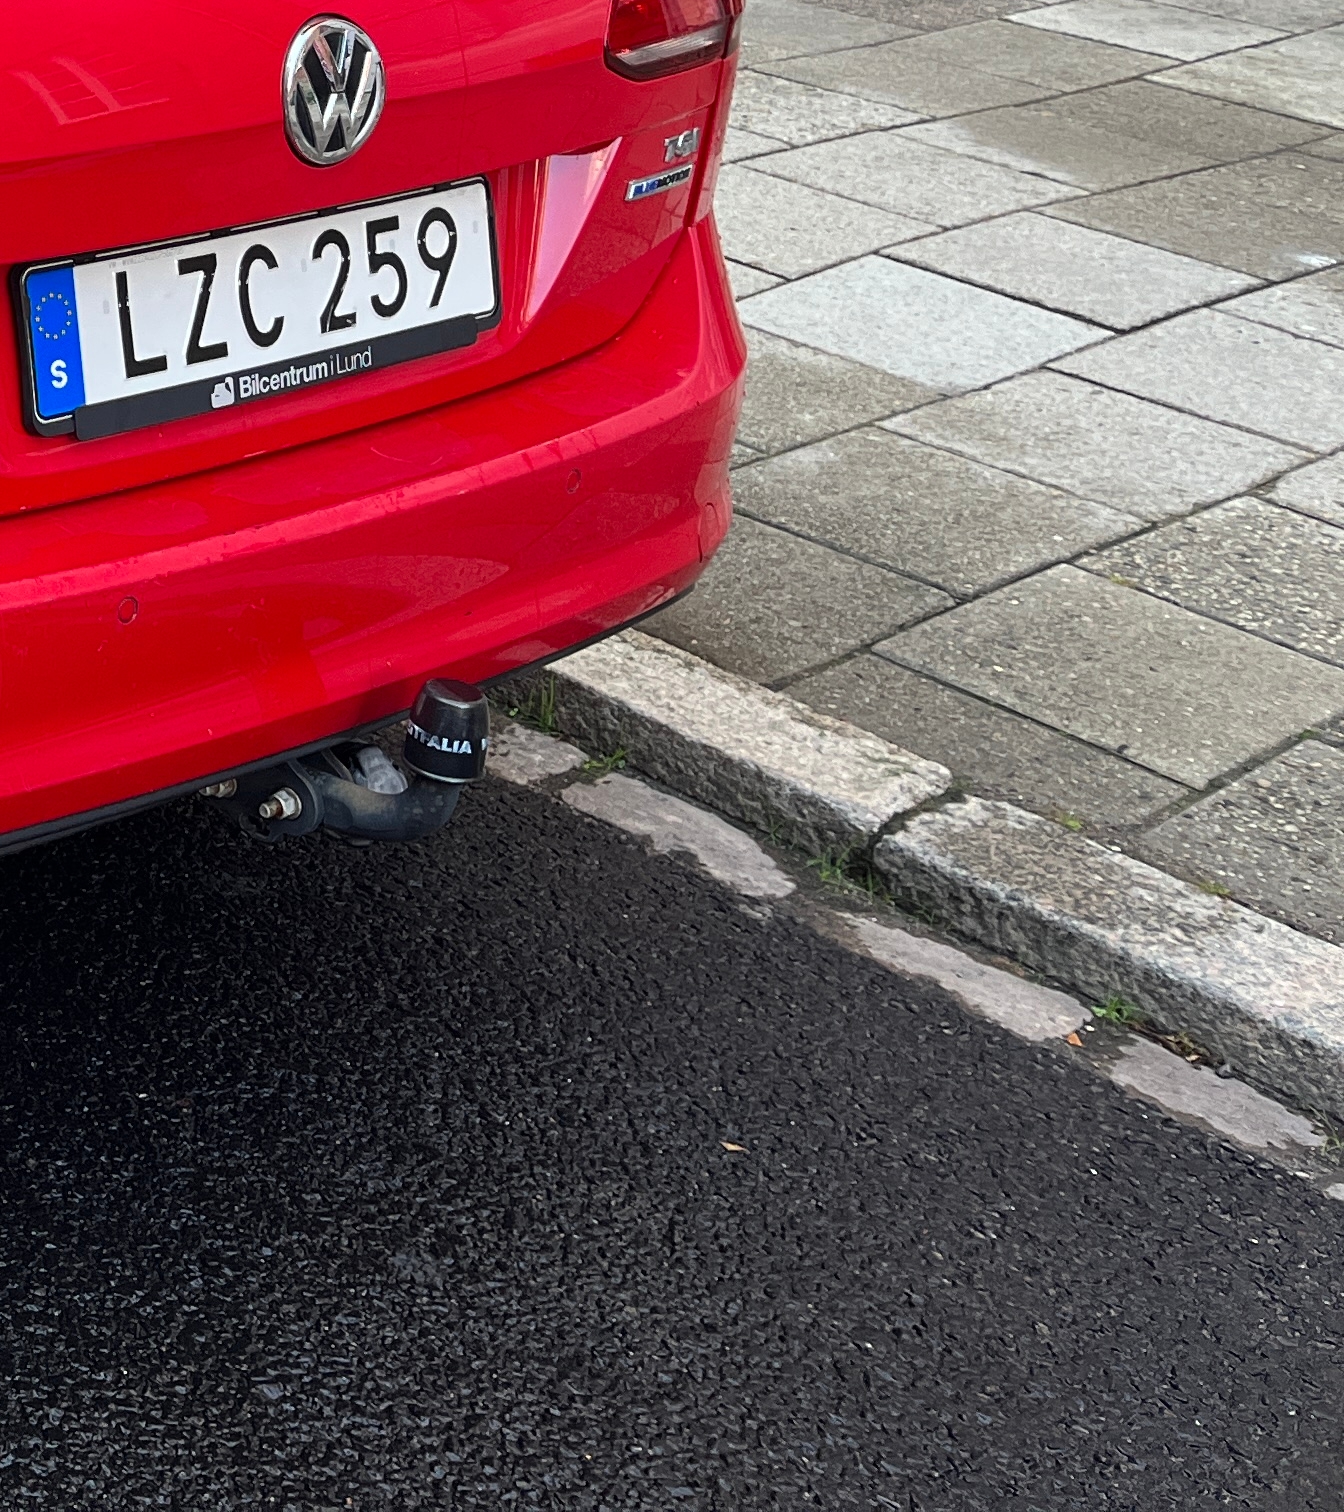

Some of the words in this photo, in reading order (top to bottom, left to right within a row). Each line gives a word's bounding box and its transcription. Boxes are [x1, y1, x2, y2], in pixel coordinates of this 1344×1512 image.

[115, 242, 286, 379] LZC
[312, 206, 458, 334] 259
[50, 358, 69, 389] S
[238, 361, 329, 399] Bilcentrum
[335, 345, 373, 375] Lund
